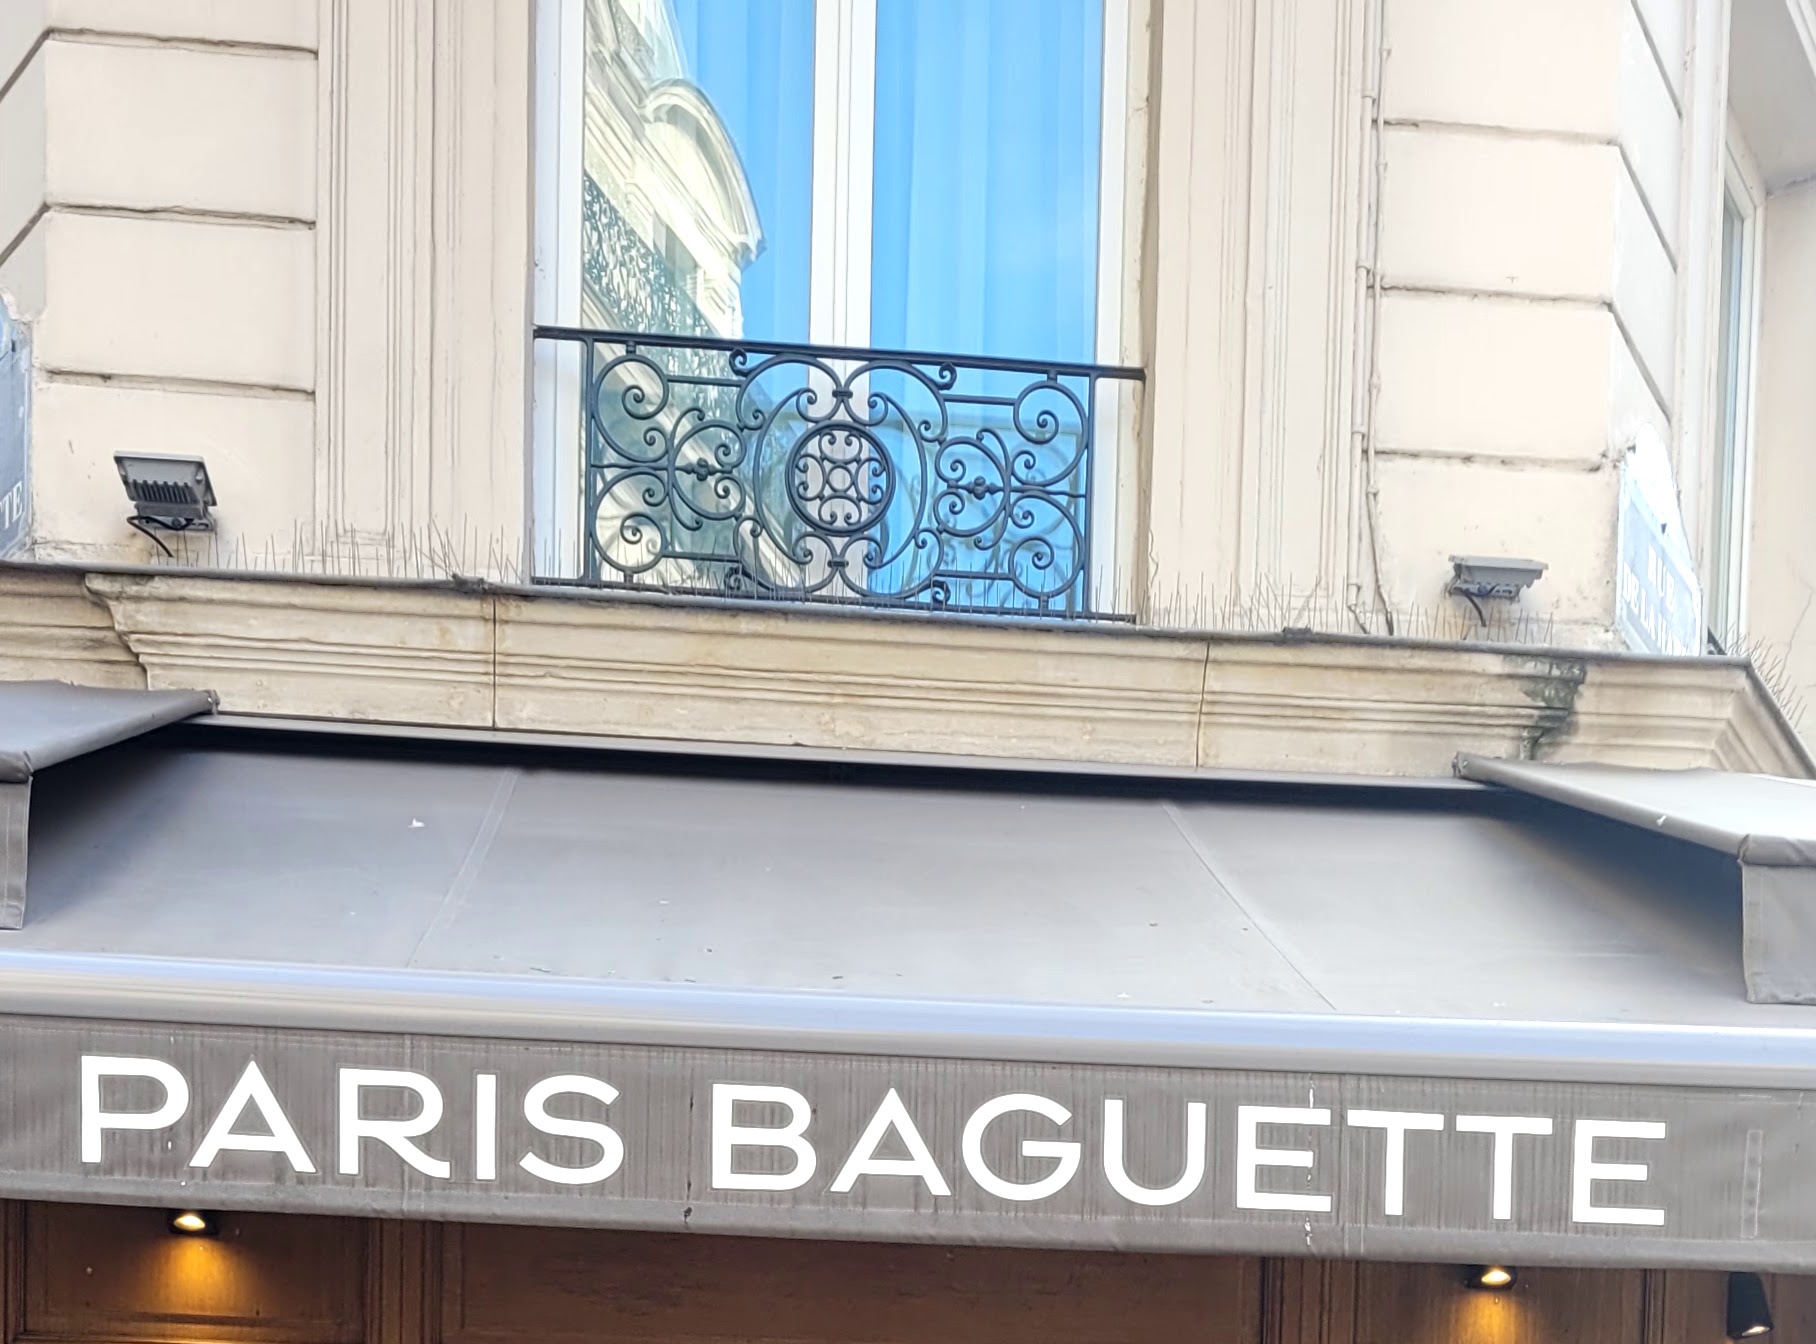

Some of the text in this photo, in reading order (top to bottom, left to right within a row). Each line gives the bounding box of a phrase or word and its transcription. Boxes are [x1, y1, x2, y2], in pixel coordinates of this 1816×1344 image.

[1623, 560, 1640, 615] DE
[1640, 587, 1656, 641] LA
[1647, 543, 1675, 613] RUE
[81, 1054, 1667, 1227] PARIS BAGUETTE
